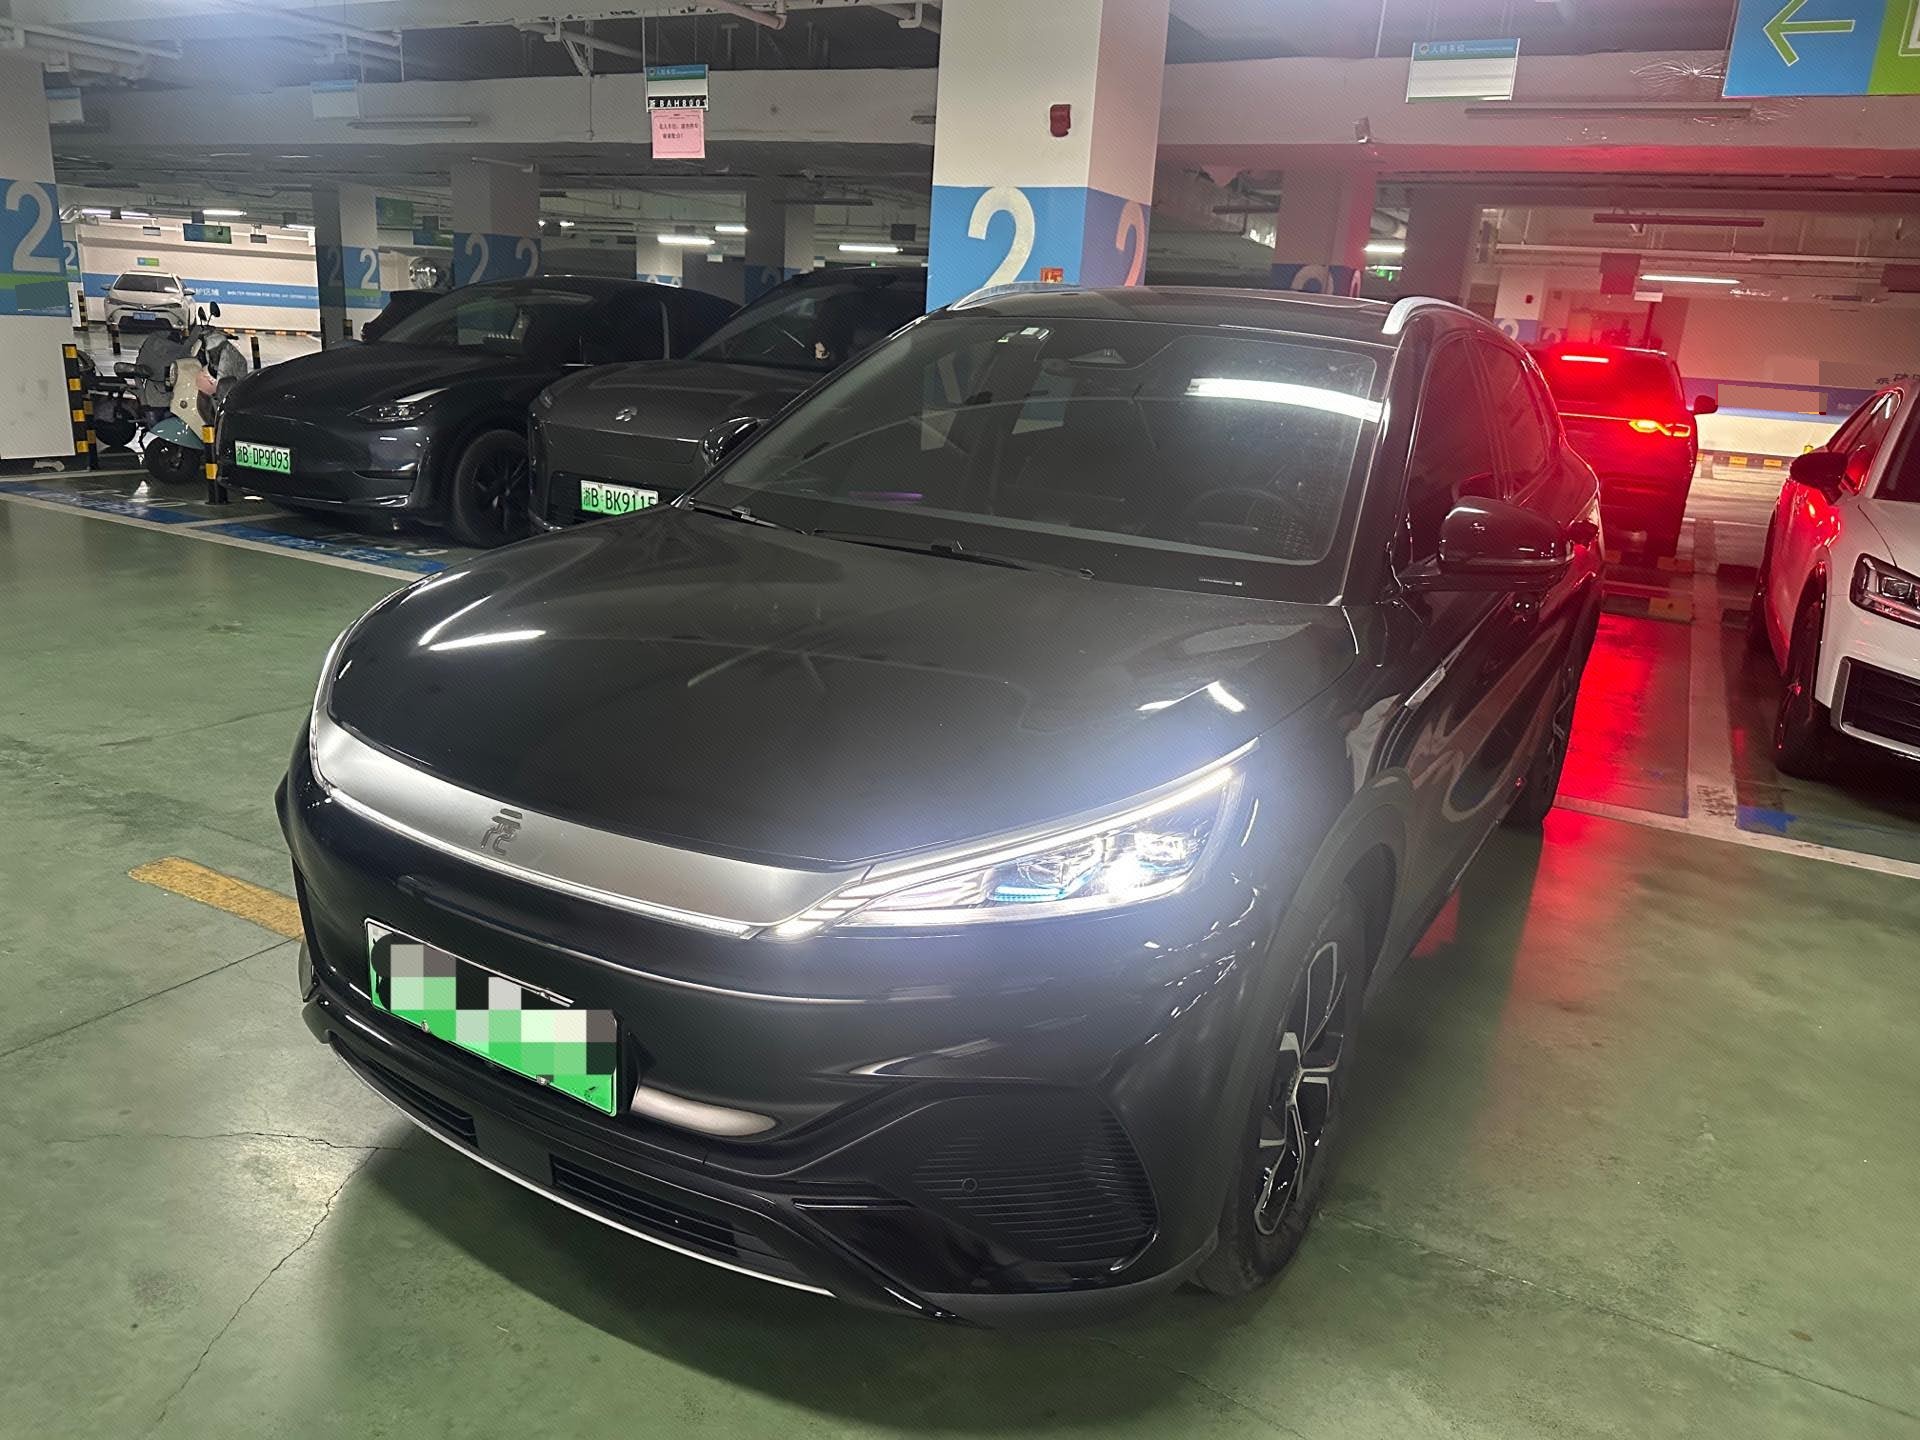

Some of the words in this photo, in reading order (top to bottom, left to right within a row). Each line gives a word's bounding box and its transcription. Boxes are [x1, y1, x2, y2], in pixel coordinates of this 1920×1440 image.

[6, 180, 61, 273] 2
[359, 248, 380, 290] 2
[465, 232, 490, 284] 2
[967, 186, 1036, 290] 2
[1115, 200, 1146, 288] 2
